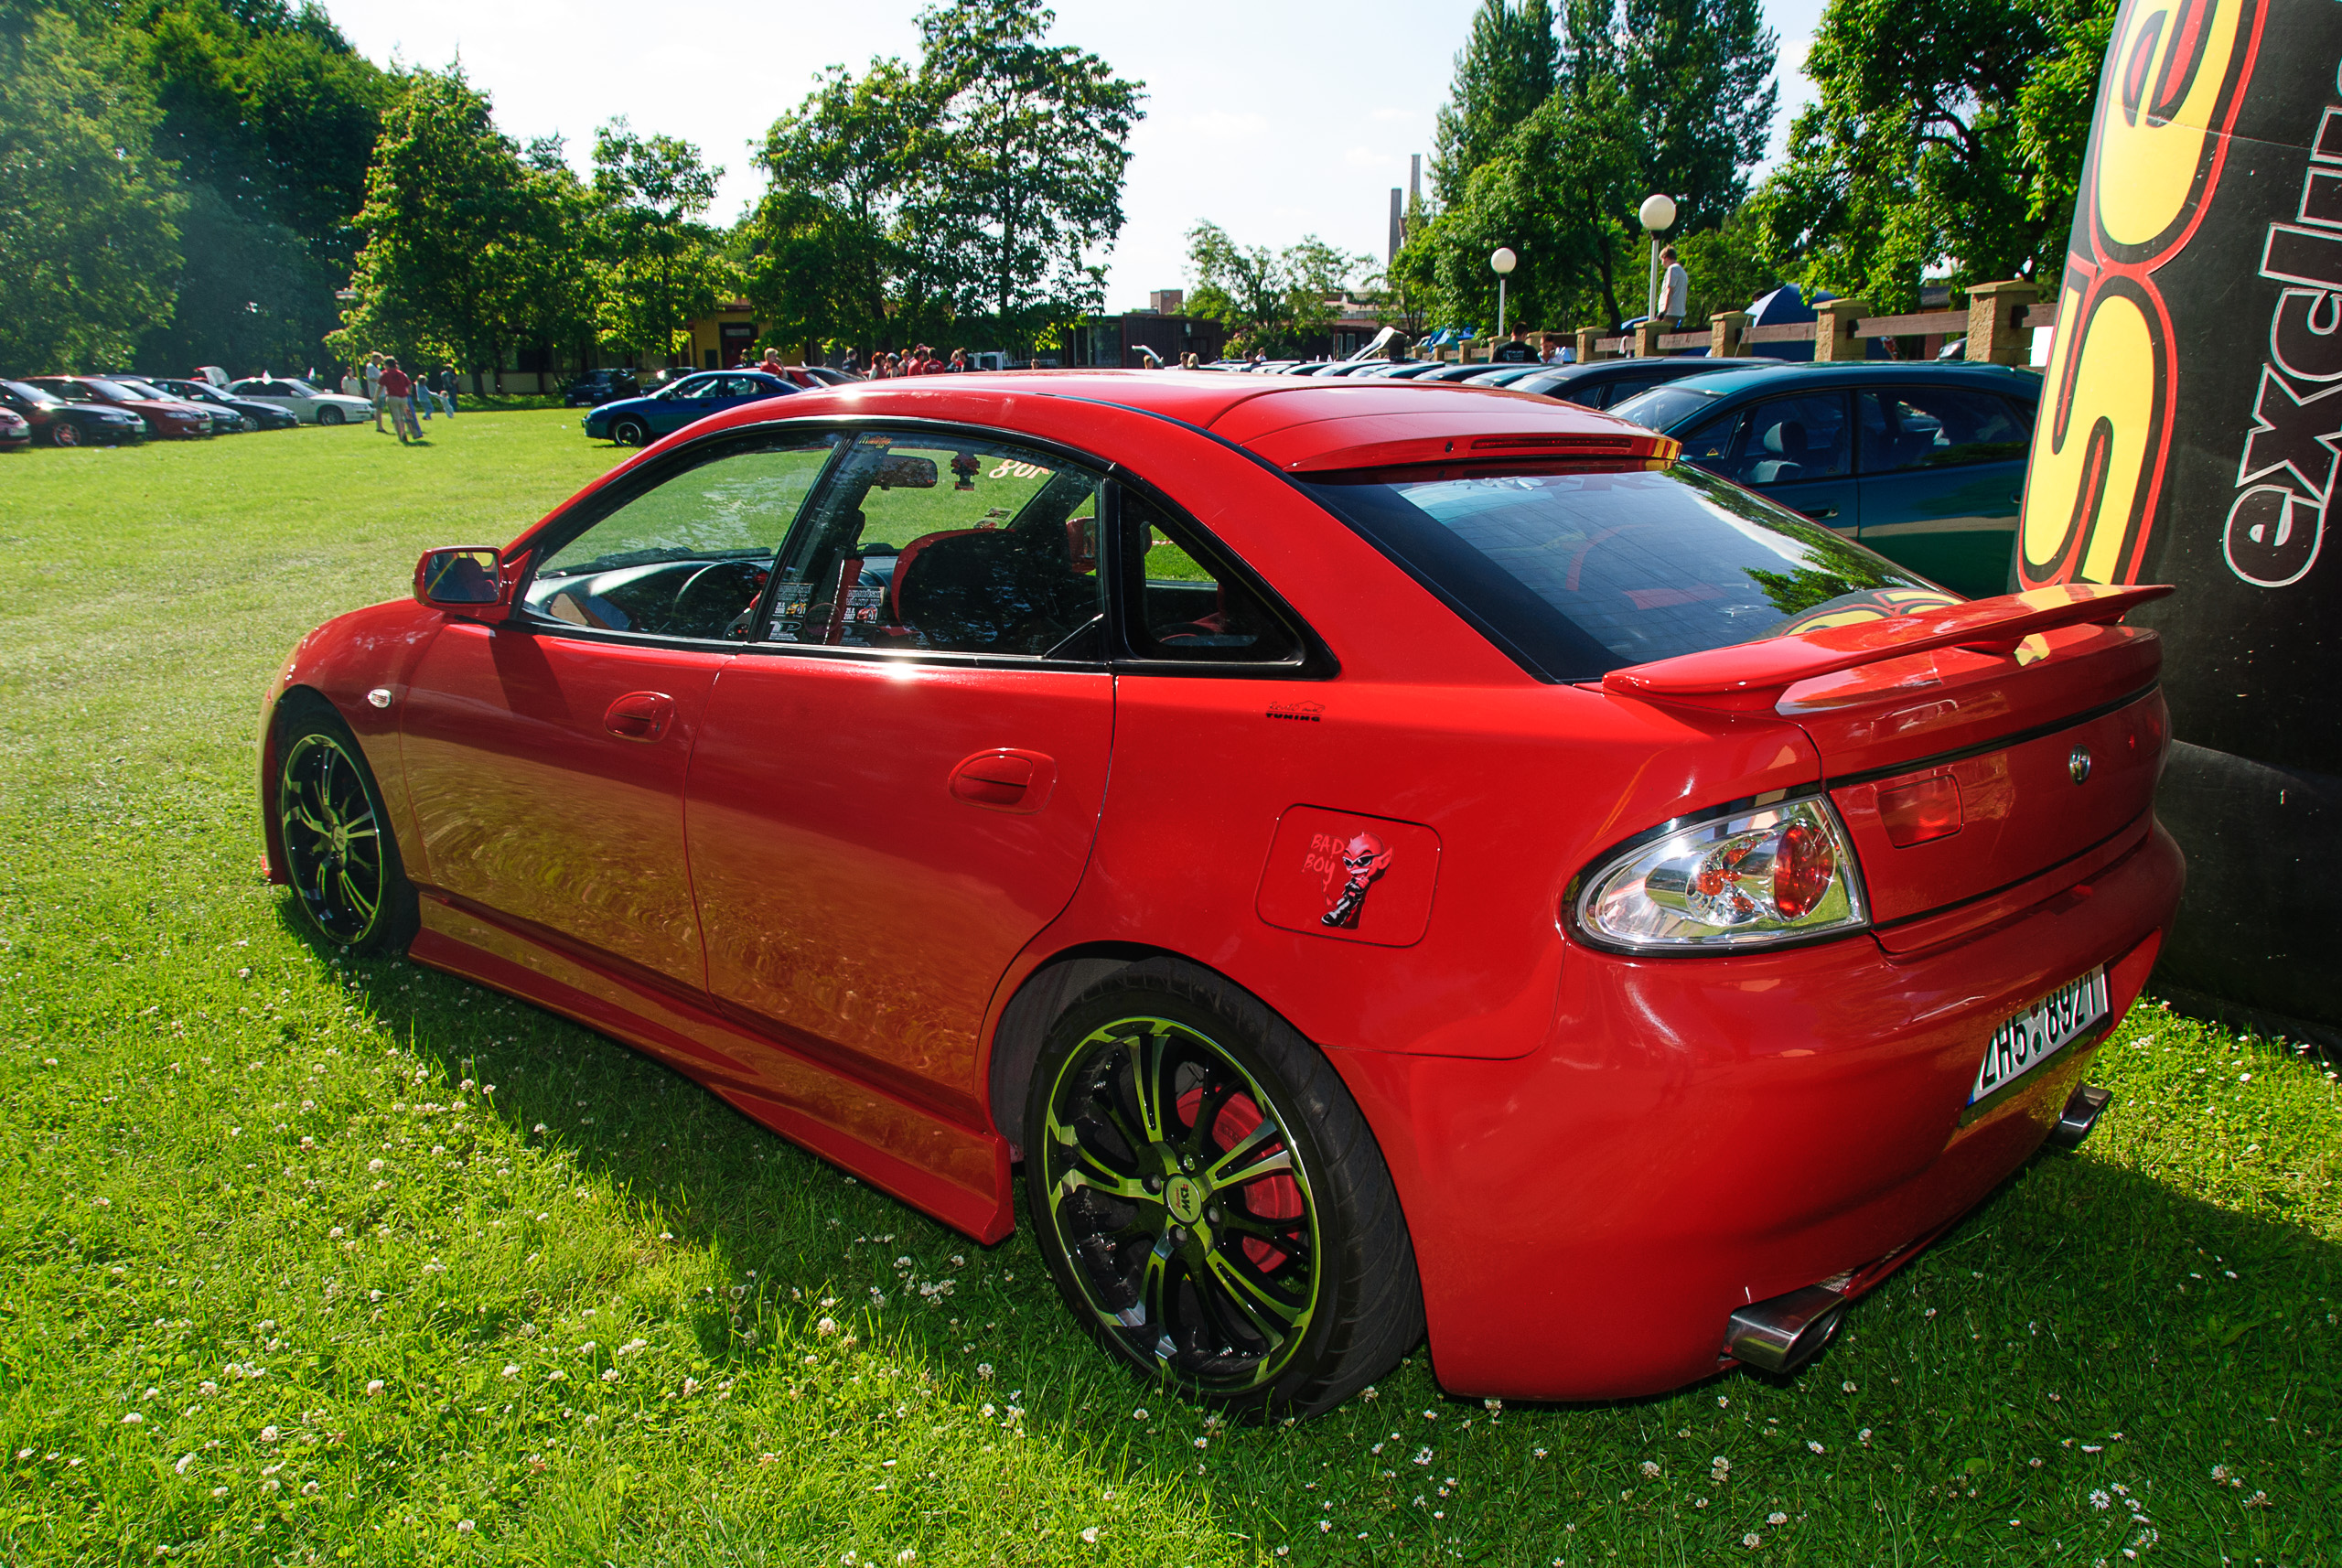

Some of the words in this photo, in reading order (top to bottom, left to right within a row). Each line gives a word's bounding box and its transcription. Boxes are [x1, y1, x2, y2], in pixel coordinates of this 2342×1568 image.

[1265, 713, 1320, 723] TUNING
[1311, 833, 1345, 859] BAD
[1301, 854, 1336, 893] BOY
